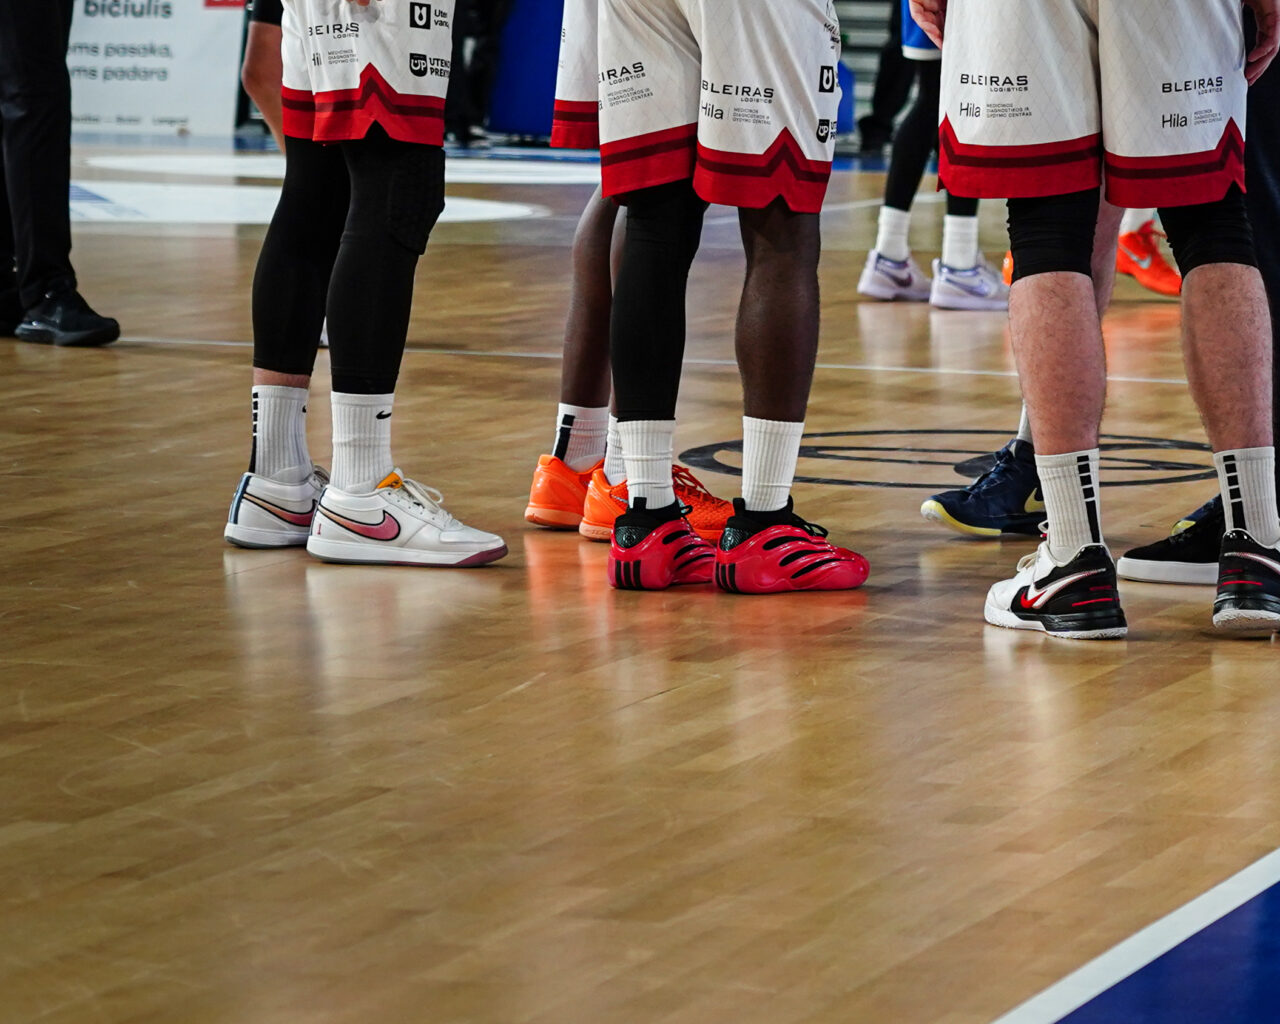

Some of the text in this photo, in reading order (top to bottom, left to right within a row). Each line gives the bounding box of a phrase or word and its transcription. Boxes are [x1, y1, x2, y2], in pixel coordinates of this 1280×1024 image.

[103, 64, 168, 83] padara
[960, 73, 1029, 87] BLEIRAS
[702, 80, 774, 98] BLEIRAS
[1162, 76, 1223, 93] BLEIRAS
[959, 102, 981, 118] Hila
[1162, 113, 1188, 128] Hila
